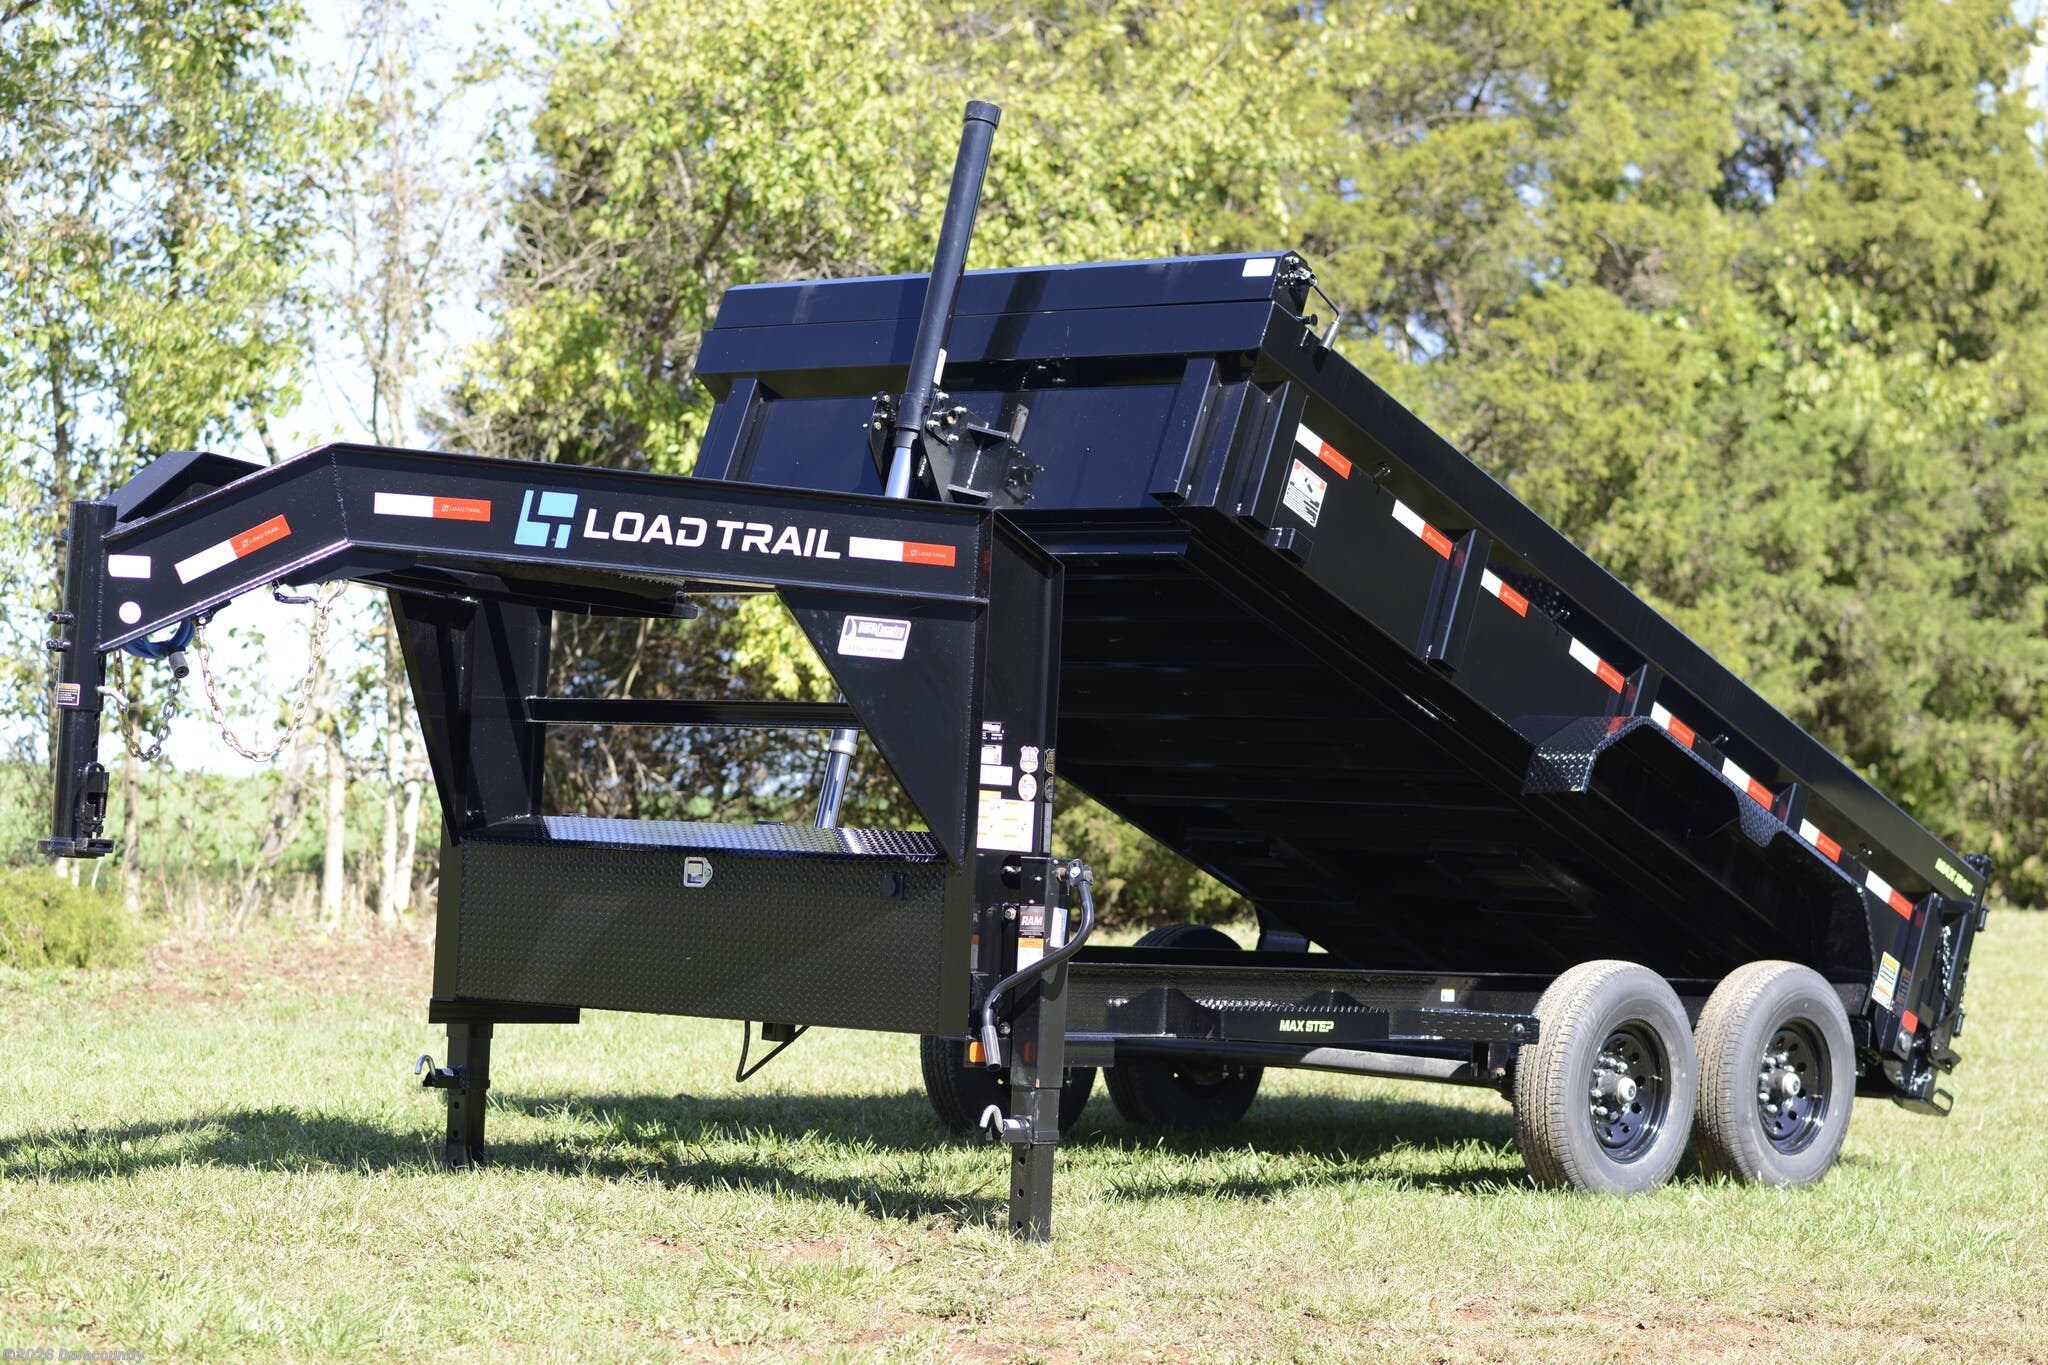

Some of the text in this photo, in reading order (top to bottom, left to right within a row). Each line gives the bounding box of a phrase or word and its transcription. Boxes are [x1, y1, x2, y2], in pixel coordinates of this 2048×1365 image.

[583, 508, 841, 560] LOAD TRAIL
[1021, 915, 1044, 926] RAM
[1279, 1019, 1335, 1033] MAX STEP
